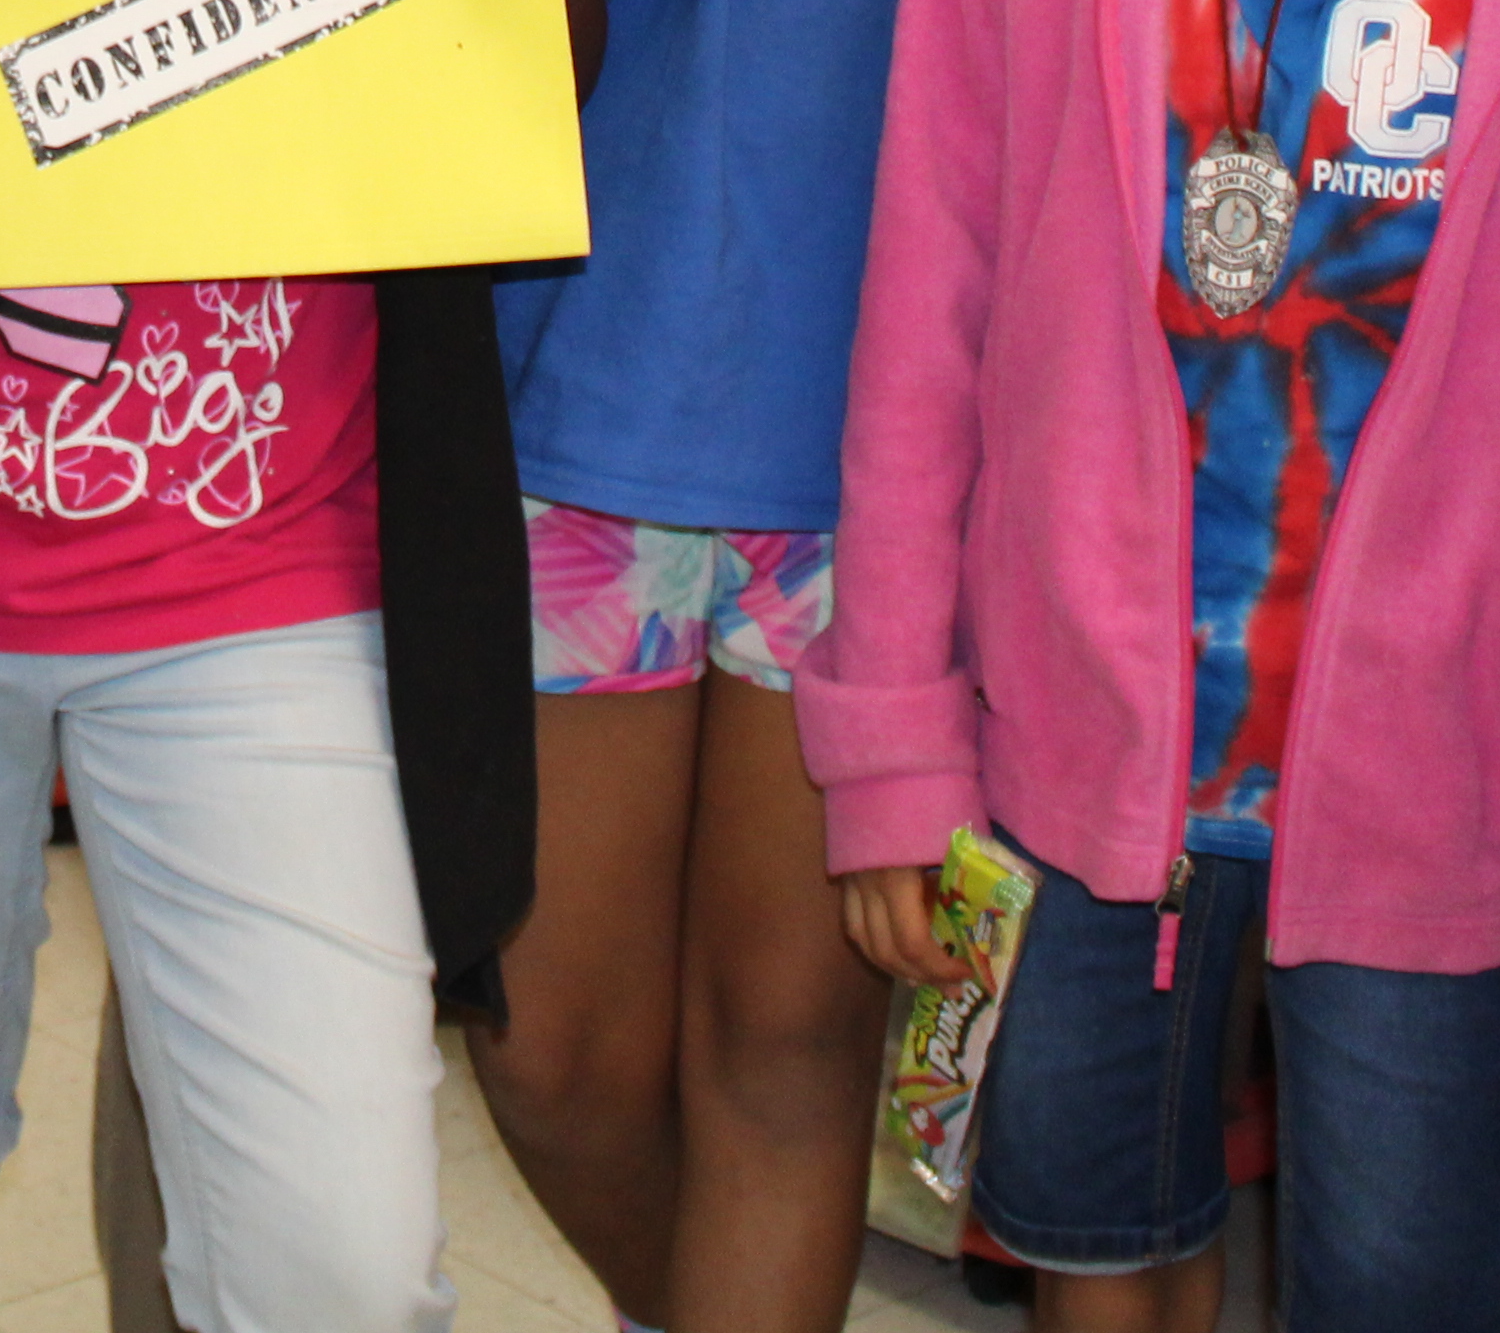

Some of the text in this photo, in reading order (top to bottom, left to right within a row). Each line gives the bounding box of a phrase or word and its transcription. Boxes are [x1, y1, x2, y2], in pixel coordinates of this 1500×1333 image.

[1215, 159, 1275, 182] POLICE
[1312, 158, 1445, 201] PATRIOTS
[1210, 175, 1275, 202] CRIME SCENE
[1215, 271, 1242, 282] CSI
